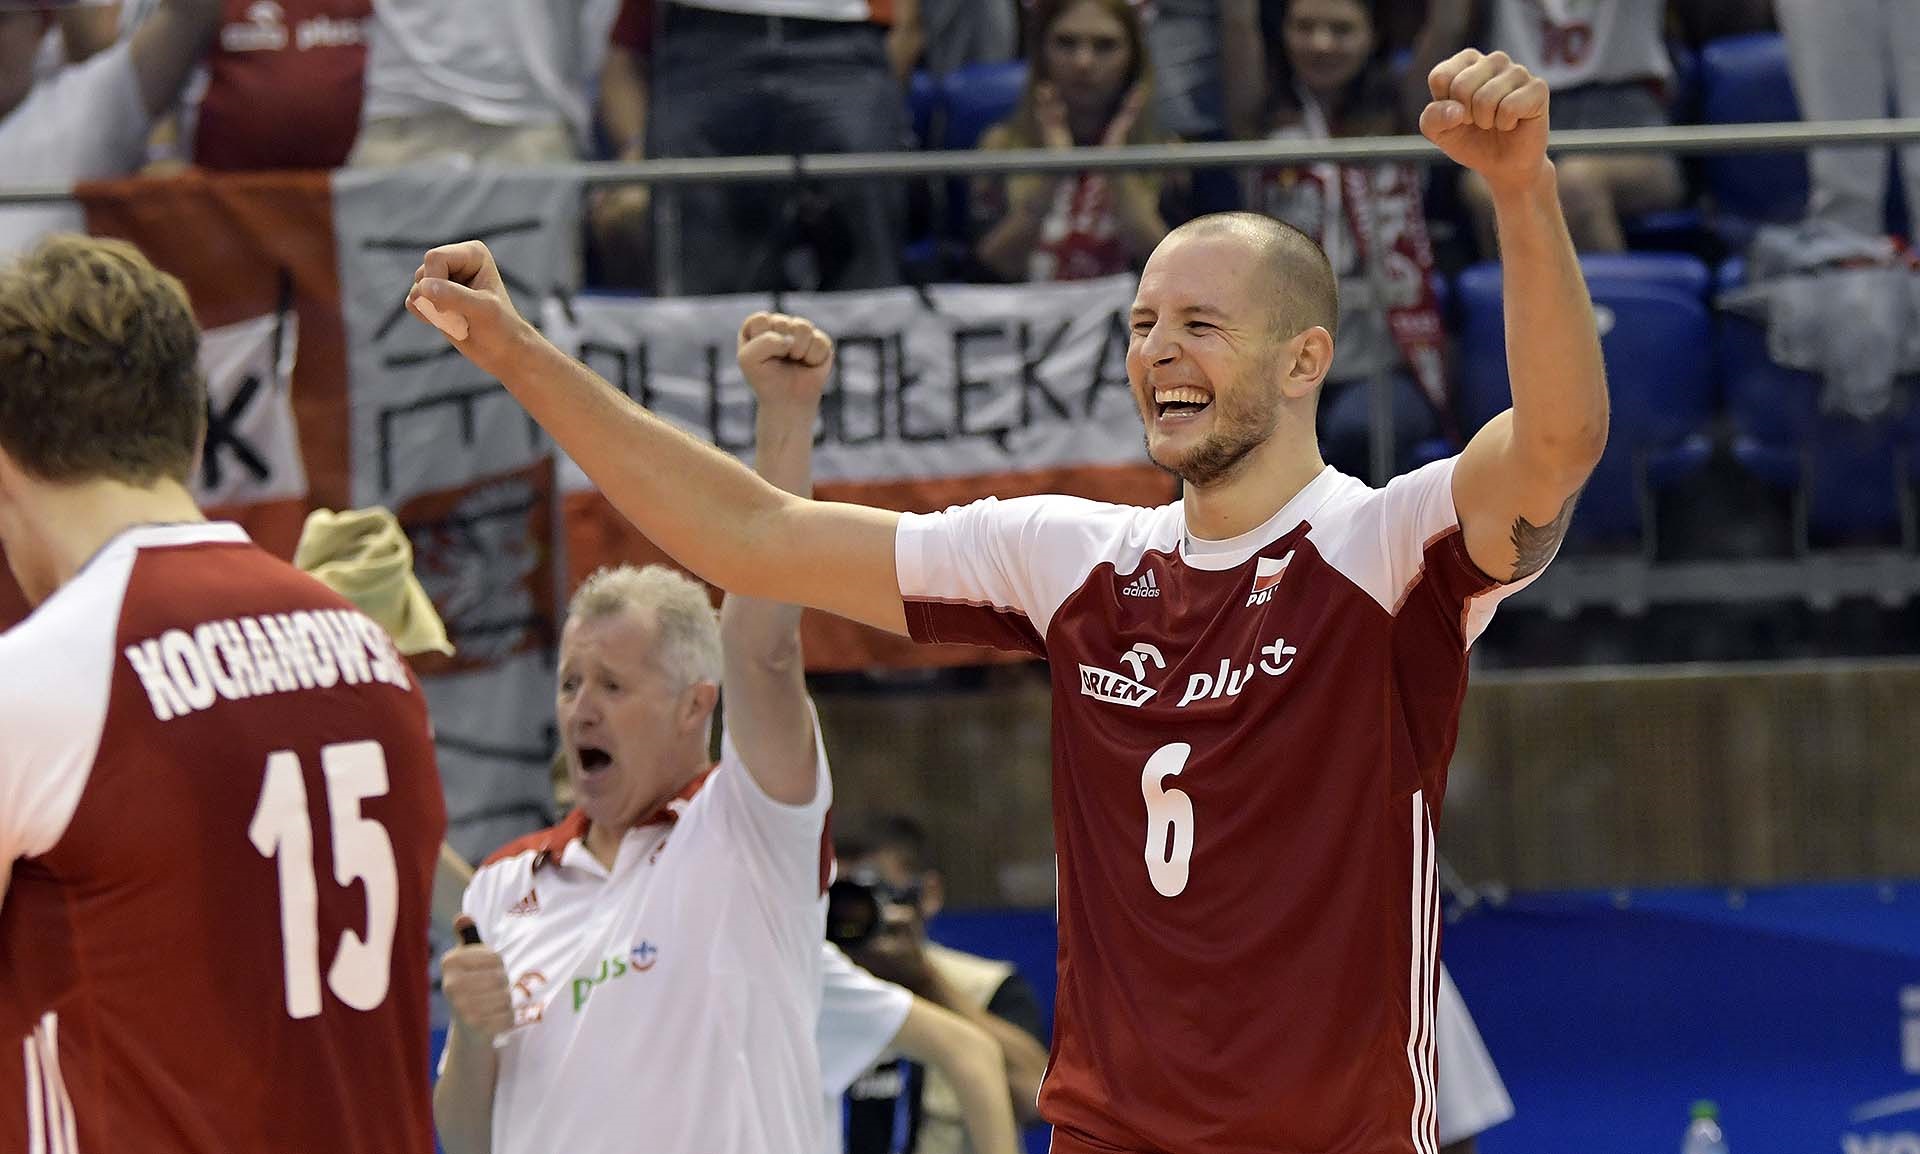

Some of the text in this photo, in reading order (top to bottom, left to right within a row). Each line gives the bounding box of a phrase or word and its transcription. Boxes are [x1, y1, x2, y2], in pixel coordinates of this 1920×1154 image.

[1122, 585, 1161, 598] adidas
[1082, 670, 1147, 702] ORLEN
[1142, 742, 1194, 897] 6
[248, 740, 399, 1020] 15
